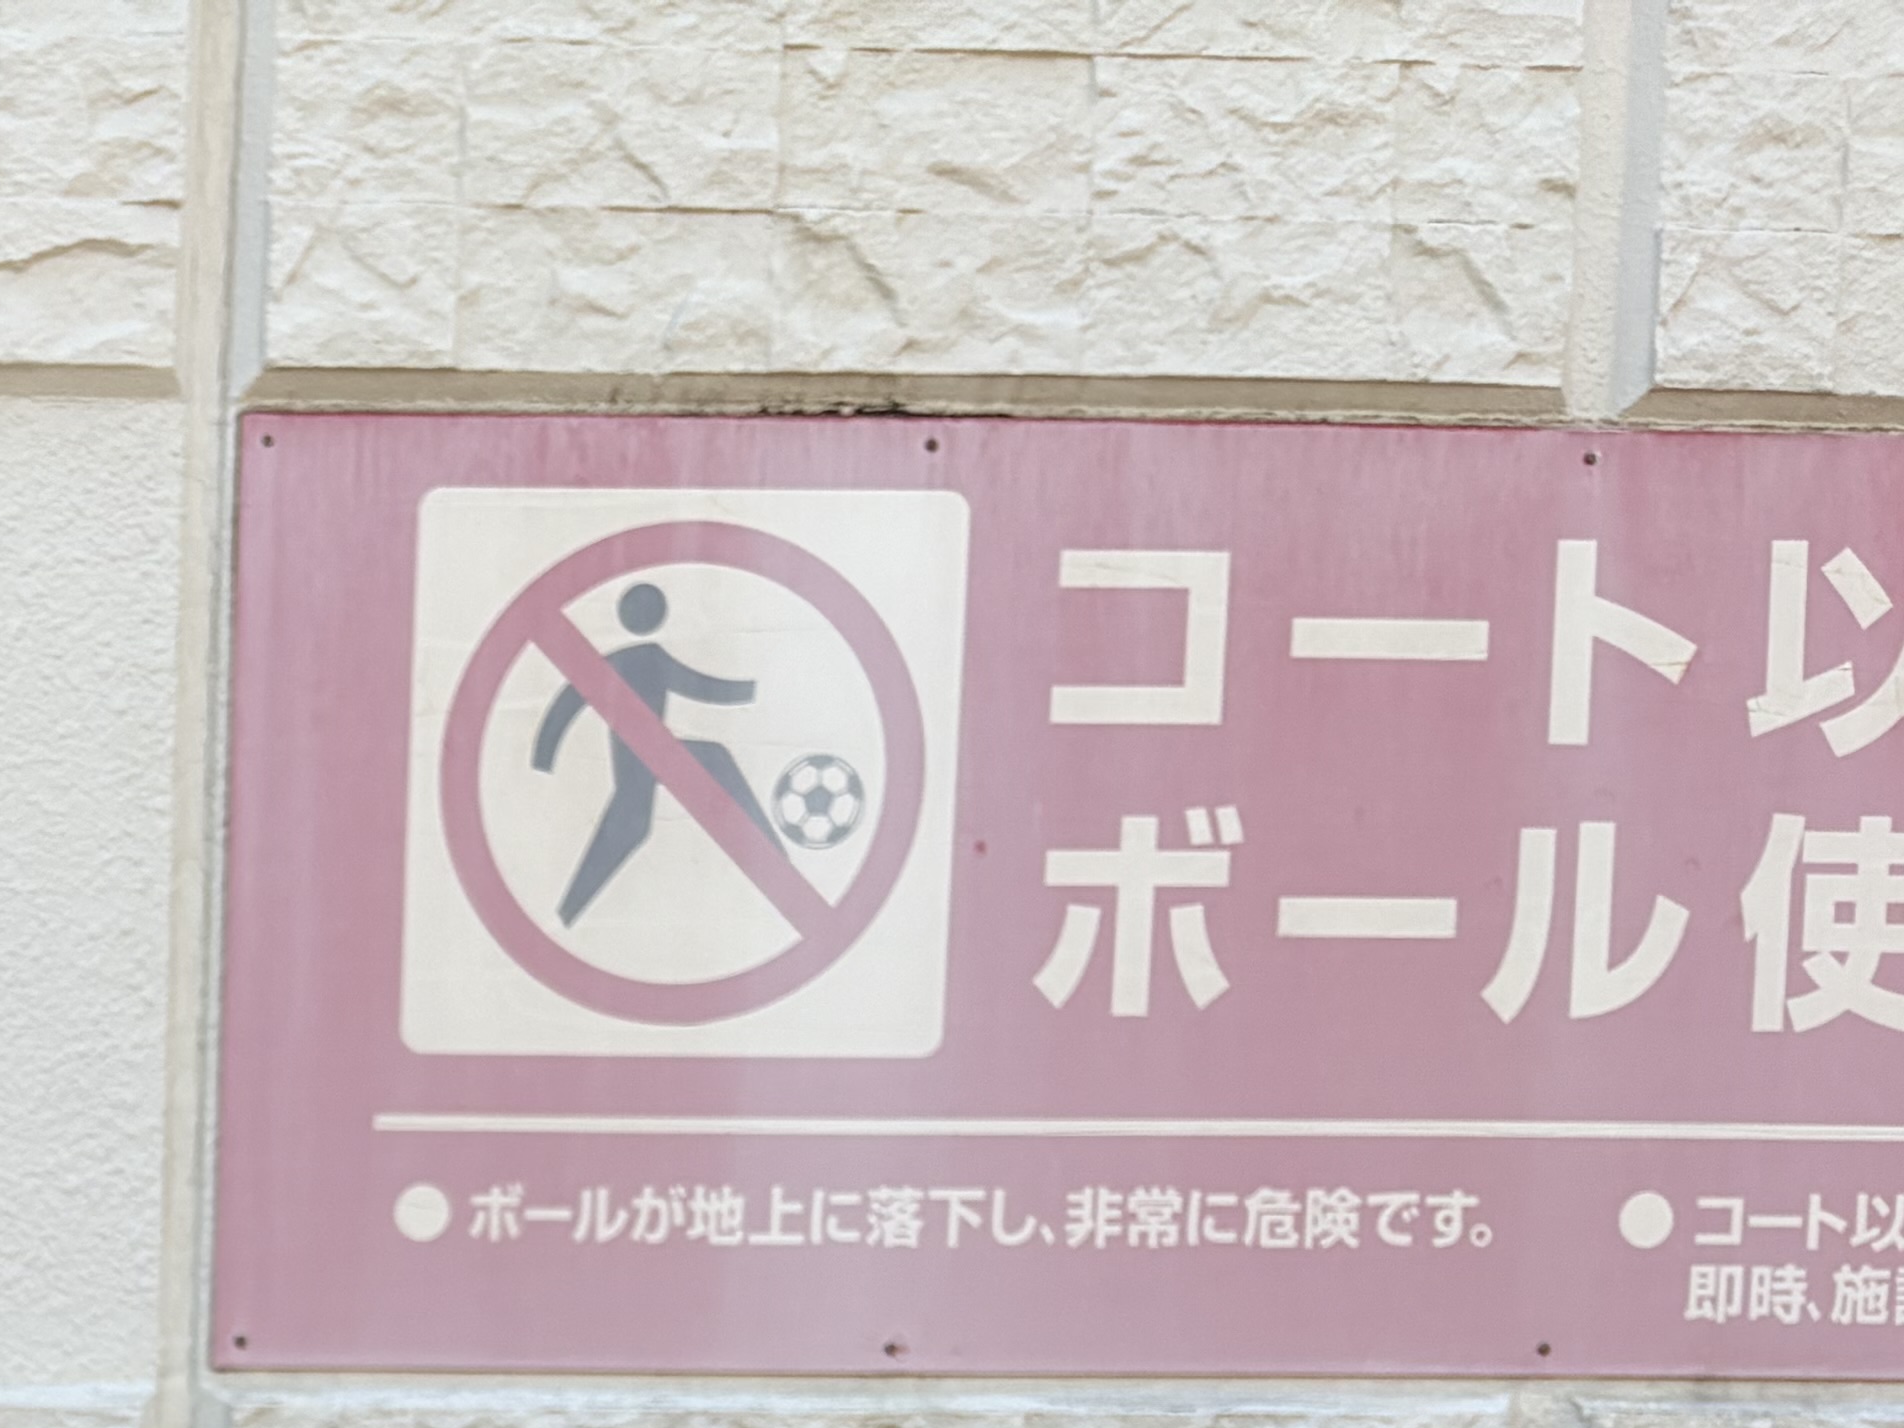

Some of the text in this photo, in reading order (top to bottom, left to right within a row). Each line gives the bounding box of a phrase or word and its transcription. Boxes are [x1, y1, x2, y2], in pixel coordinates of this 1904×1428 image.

[1048, 538, 1904, 758] コート以
[468, 1182, 1495, 1250] ボールが地上に落下し、非常に危険です。
[1683, 1263, 1904, 1326] 即時、施
